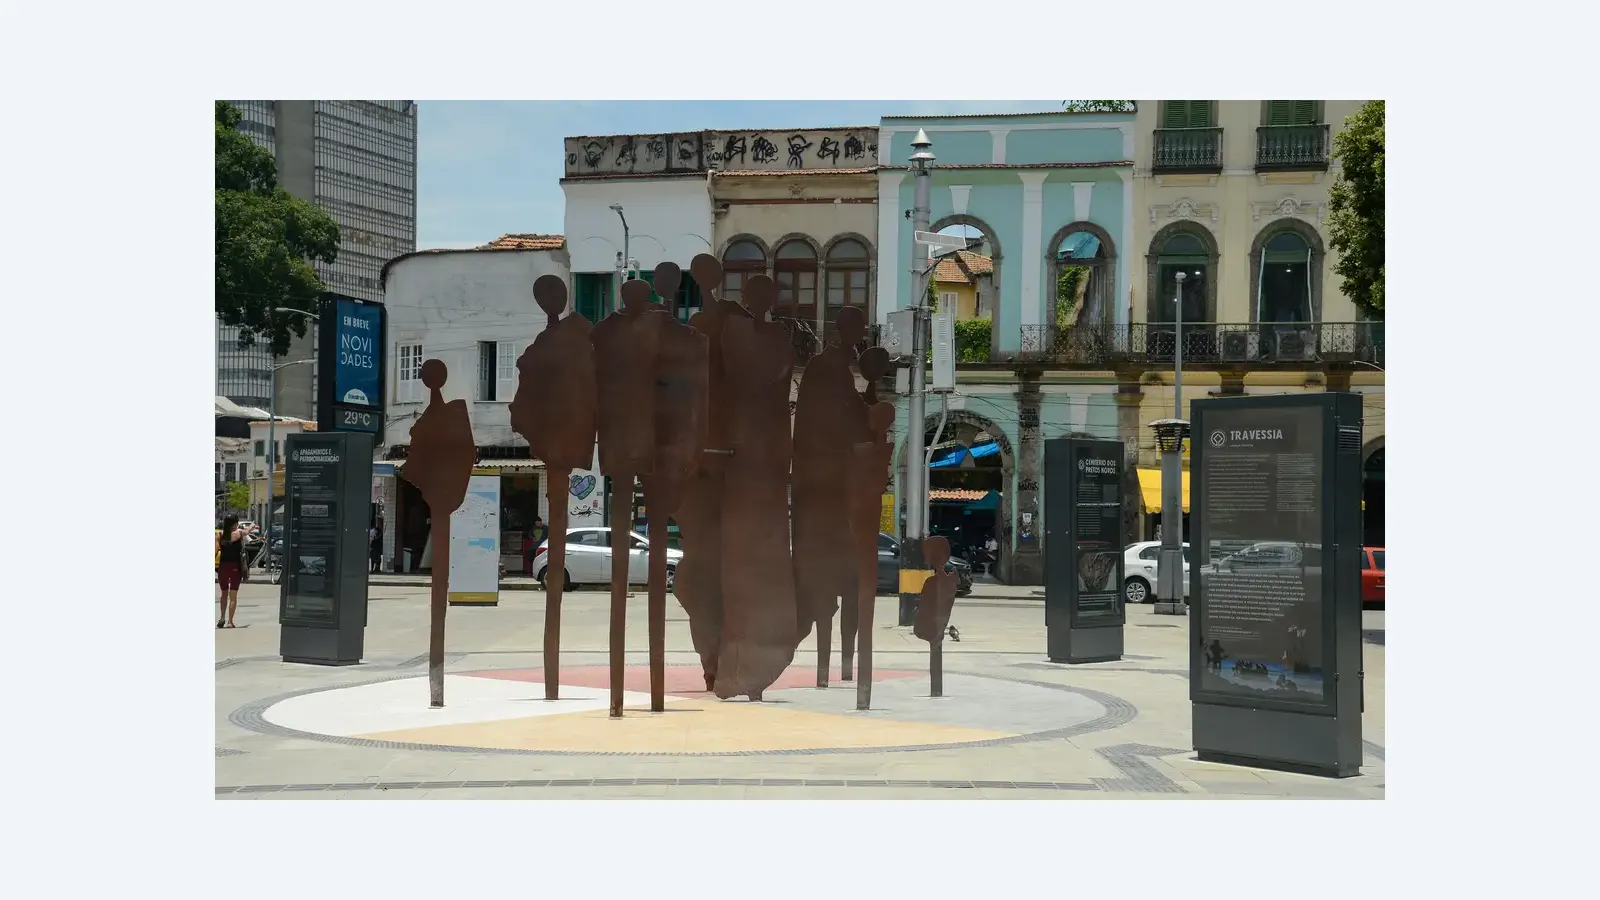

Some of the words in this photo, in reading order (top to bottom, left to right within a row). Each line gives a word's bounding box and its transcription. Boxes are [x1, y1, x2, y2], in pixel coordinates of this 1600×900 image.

[343, 316, 352, 327] EM
[352, 318, 370, 330] BREVE
[341, 333, 372, 354] NOVI
[1230, 429, 1283, 441] TRAVESSIA
